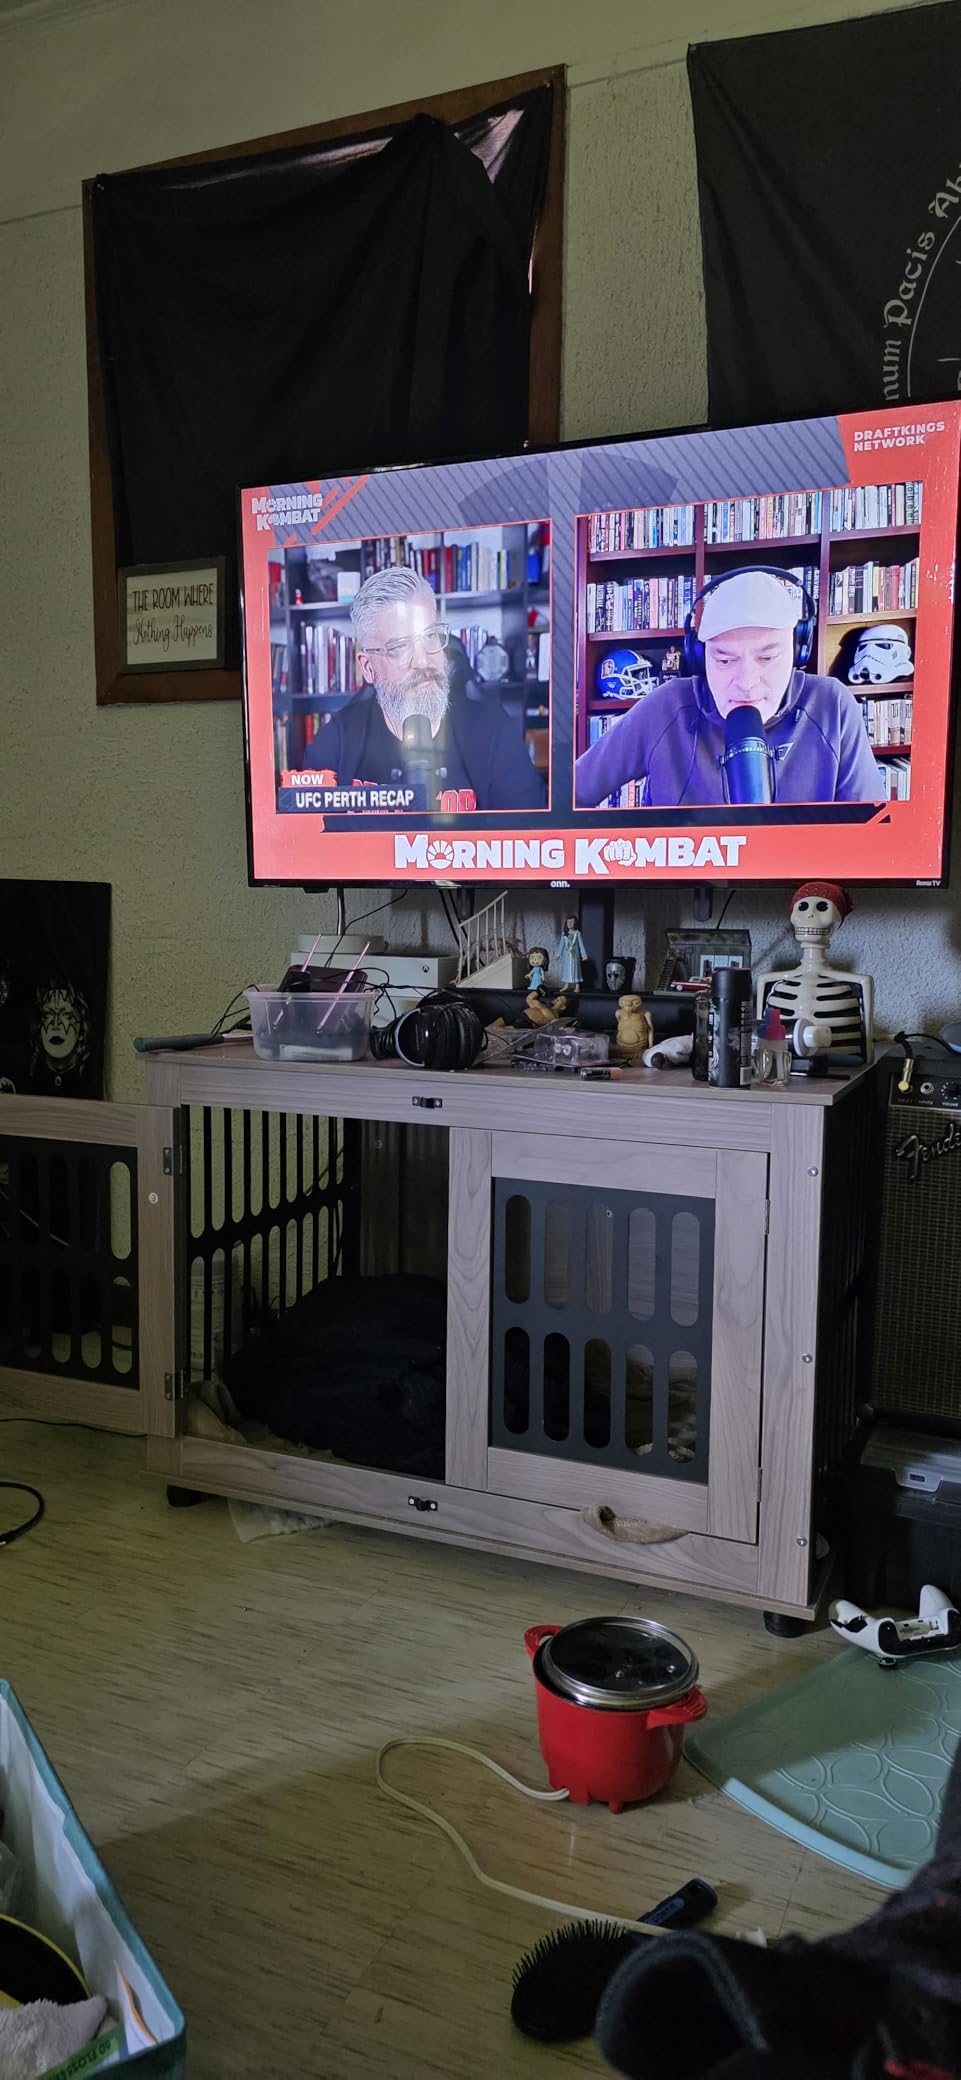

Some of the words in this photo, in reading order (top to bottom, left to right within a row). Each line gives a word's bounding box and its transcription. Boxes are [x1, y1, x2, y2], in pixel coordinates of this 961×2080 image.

[928, 165, 961, 218] Ab
[884, 232, 935, 328] Pacis
[883, 339, 902, 400] num
[854, 422, 945, 441] DRAFTKINGS
[854, 435, 925, 452] NETWORK
[251, 493, 323, 515] MORNING
[256, 508, 321, 531] KOMBAT
[132, 589, 149, 612] THE
[153, 586, 180, 610] ROOM
[184, 583, 214, 607] WHERE
[134, 617, 170, 652] Nothing
[174, 614, 213, 648] Happens
[291, 773, 325, 785] NOW
[295, 791, 321, 809] UFC
[324, 789, 367, 808] PERTH
[370, 789, 414, 807] RECAP
[394, 834, 565, 869] MORNING
[574, 835, 747, 875] KOMBAT
[896, 1123, 961, 1178] Fende
